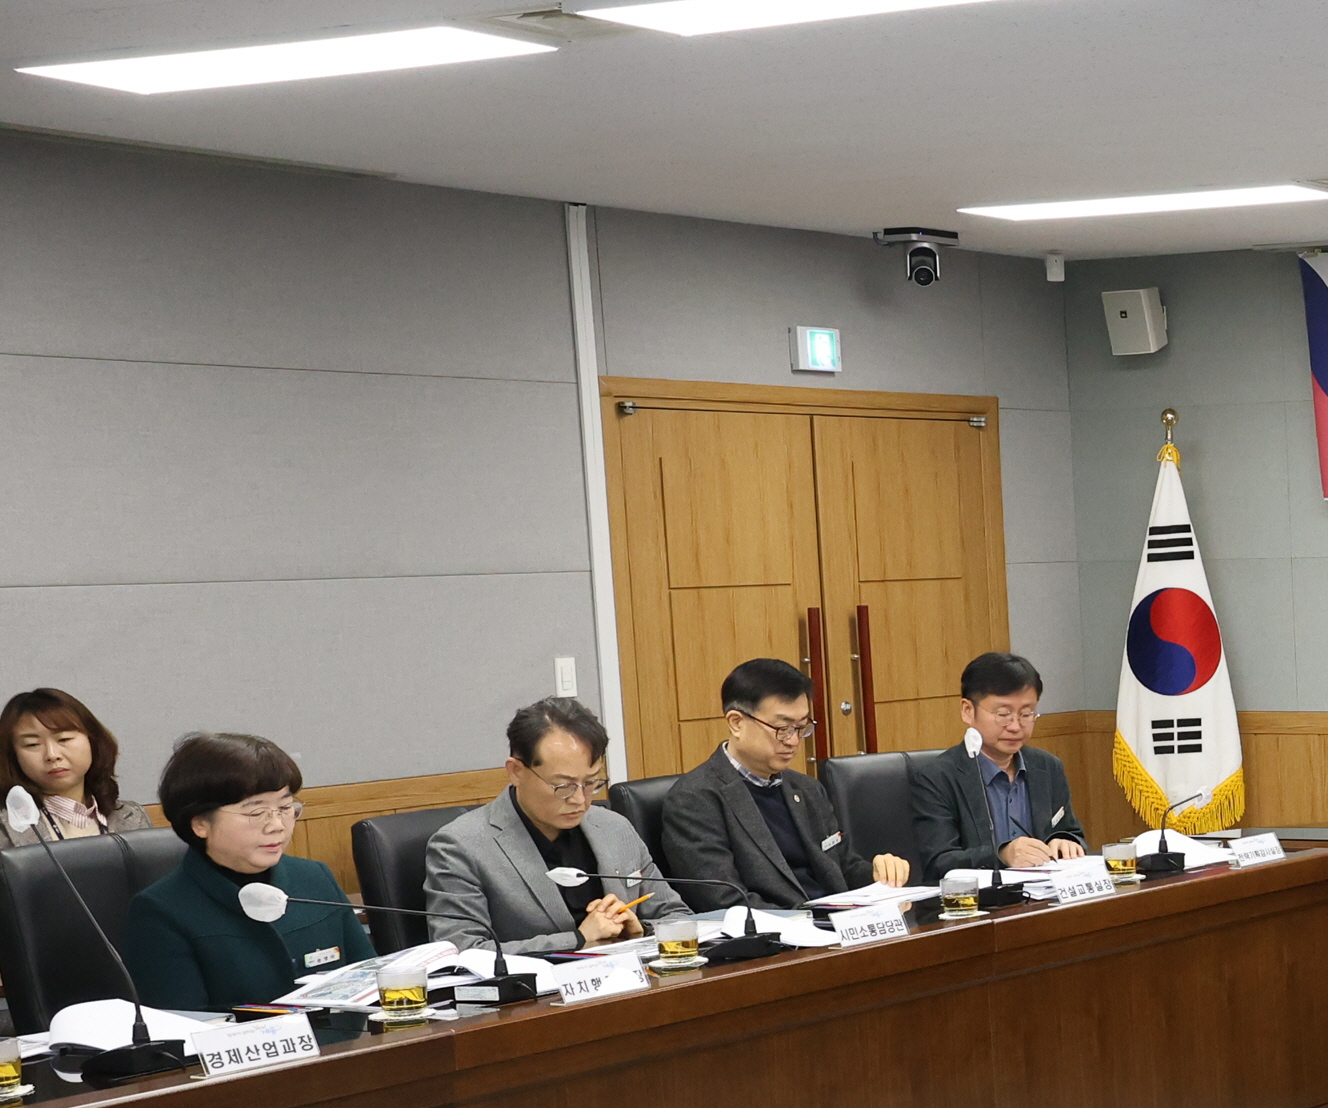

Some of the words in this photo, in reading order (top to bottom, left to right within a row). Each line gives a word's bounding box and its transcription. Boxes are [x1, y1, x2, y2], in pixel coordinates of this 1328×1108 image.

[1057, 879, 1113, 900] 건설교통실장
[840, 918, 905, 941] 시민소통담당관
[205, 1034, 315, 1070] 경제산업과장
